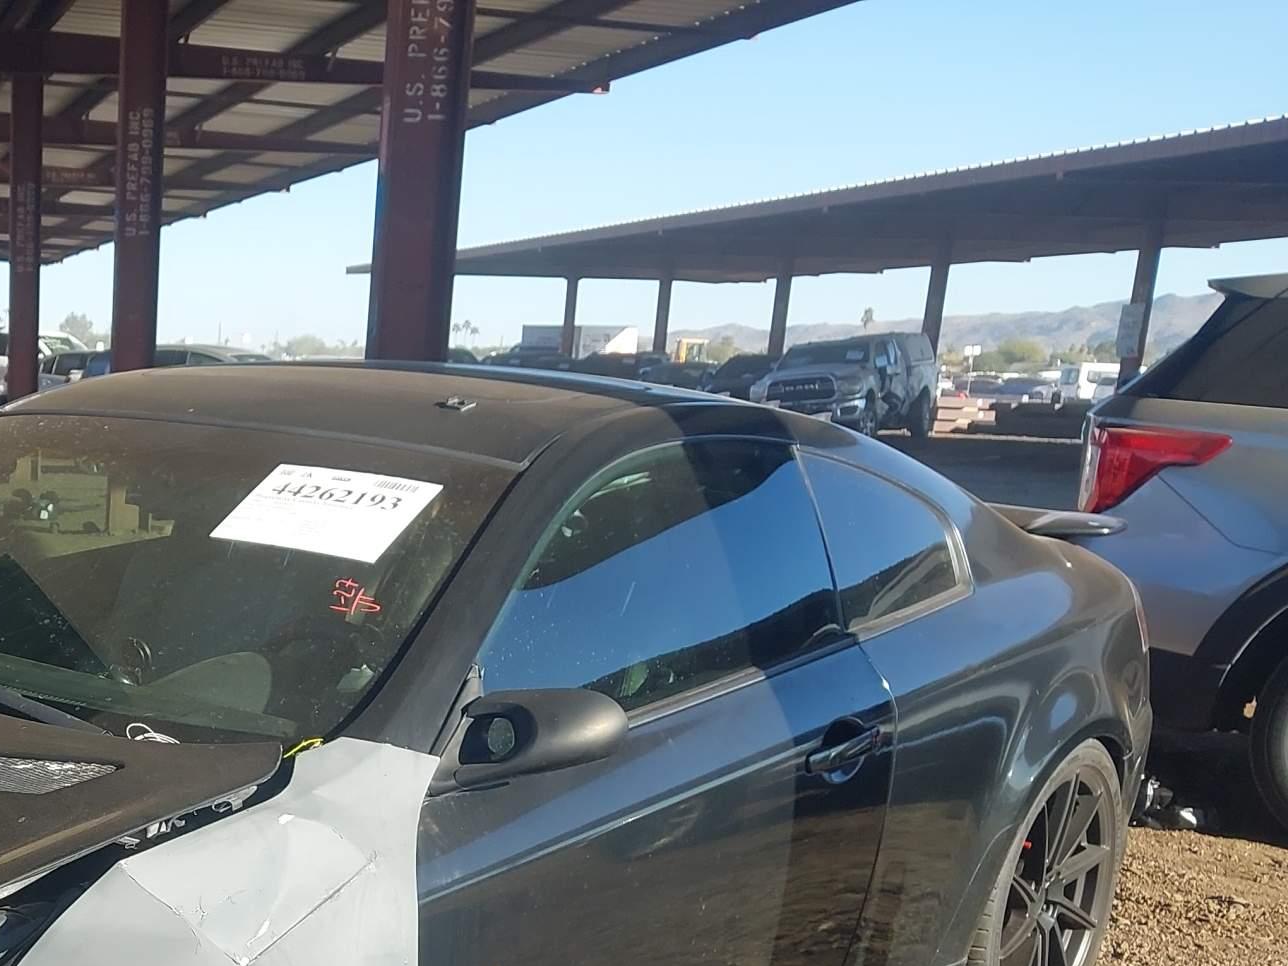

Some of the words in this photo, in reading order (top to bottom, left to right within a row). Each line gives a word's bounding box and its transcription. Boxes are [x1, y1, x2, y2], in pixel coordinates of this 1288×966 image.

[408, 0, 430, 57] PRE
[403, 73, 425, 122] U.S.
[126, 142, 140, 201] PREFAB
[272, 482, 402, 510] 44262193
